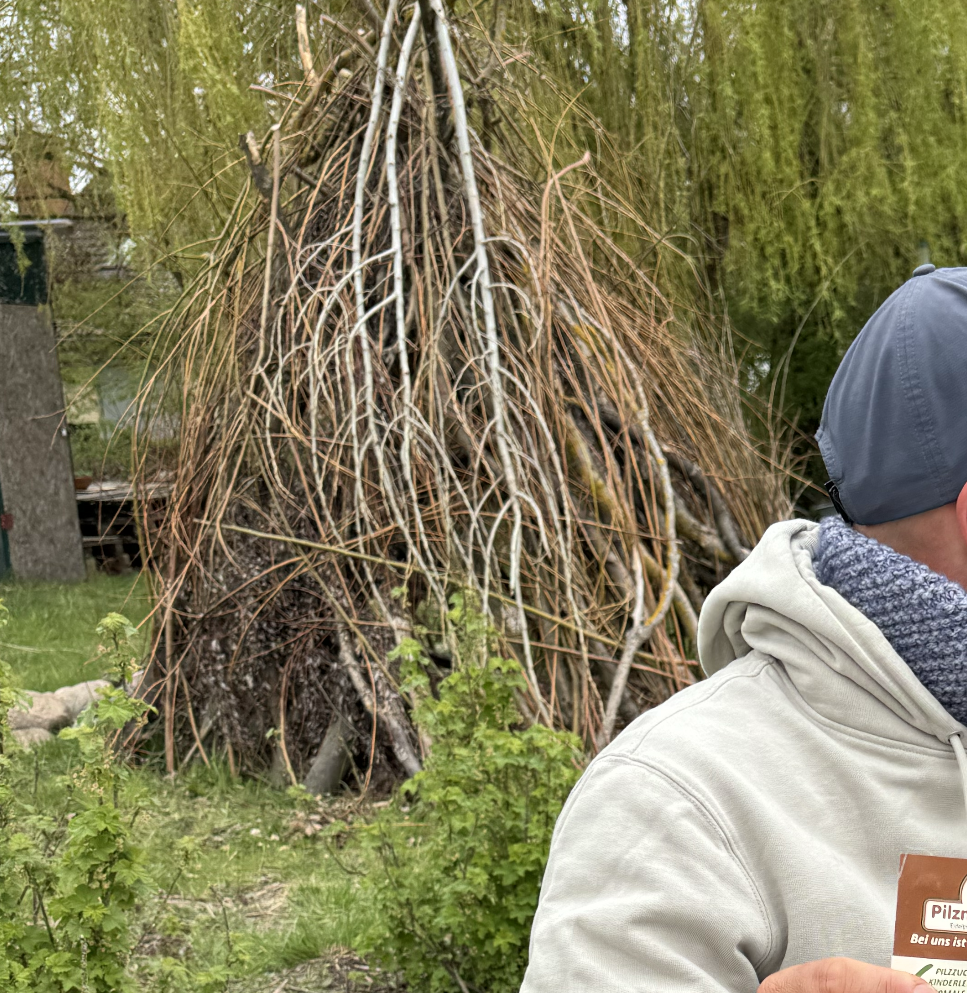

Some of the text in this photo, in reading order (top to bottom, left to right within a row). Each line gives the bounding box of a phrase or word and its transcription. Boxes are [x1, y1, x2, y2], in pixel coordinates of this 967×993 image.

[910, 933, 929, 945] Bei
[930, 937, 951, 947] uns
[952, 936, 967, 948] ist
